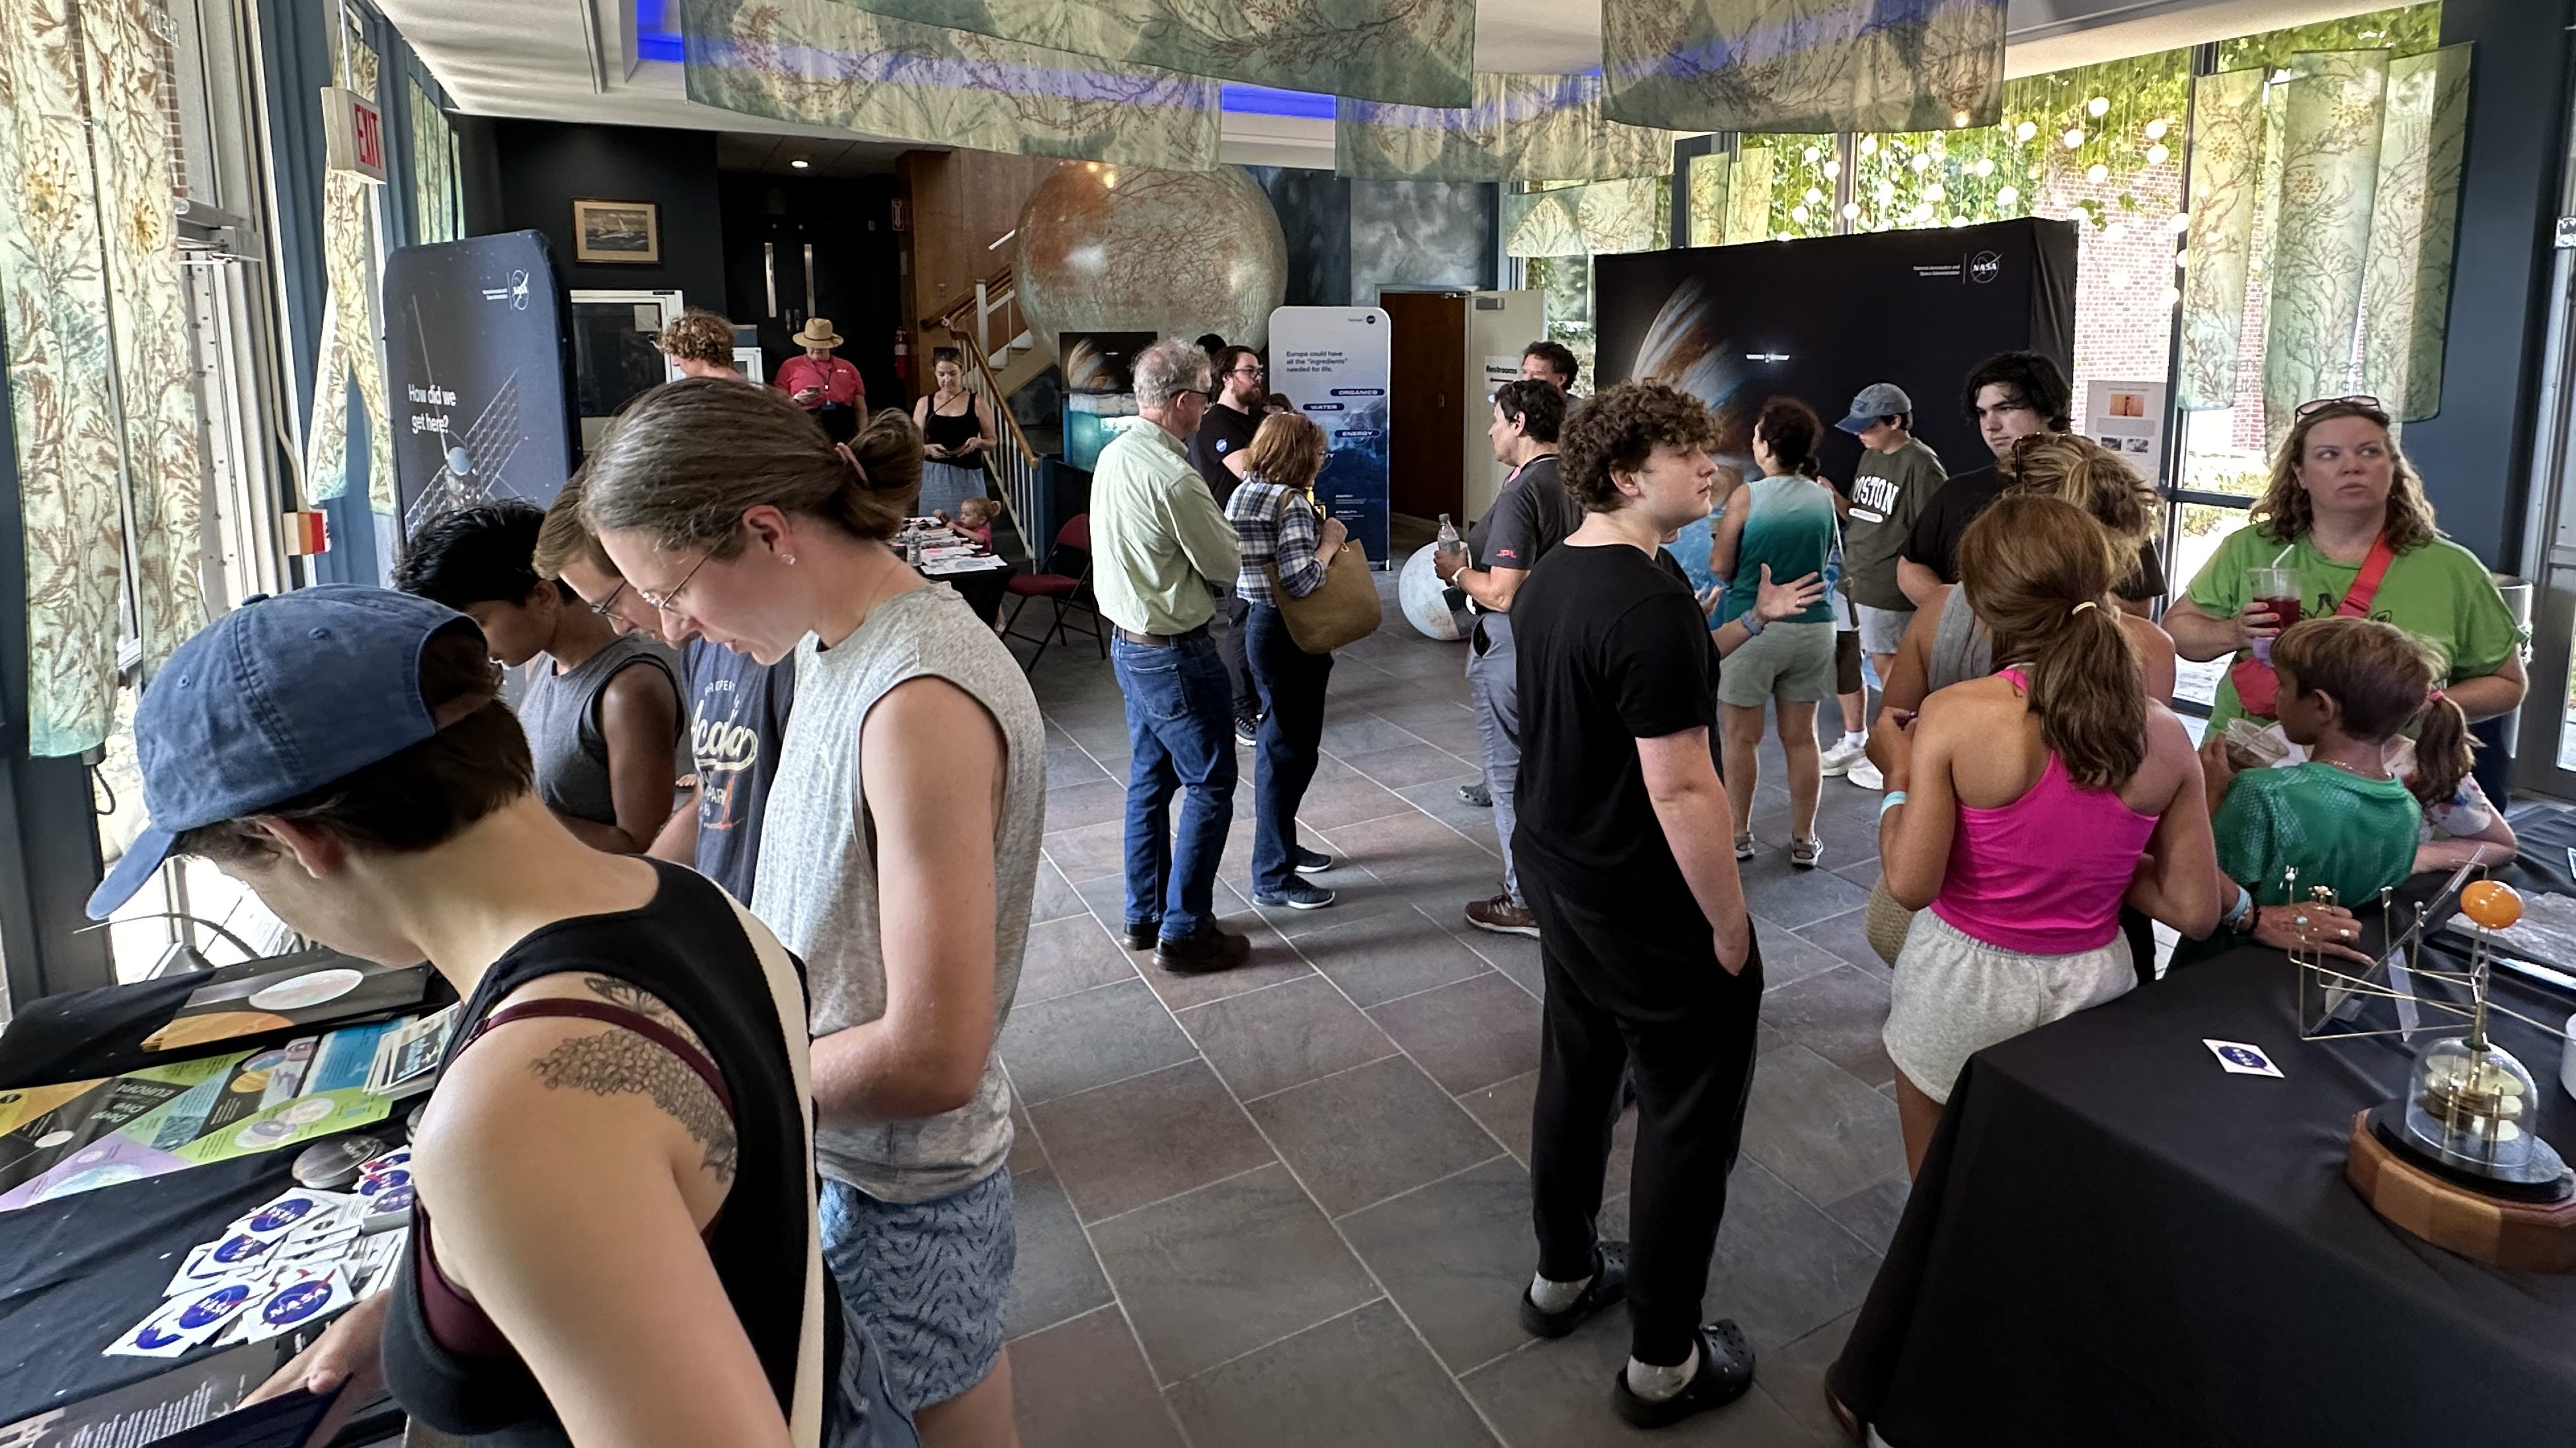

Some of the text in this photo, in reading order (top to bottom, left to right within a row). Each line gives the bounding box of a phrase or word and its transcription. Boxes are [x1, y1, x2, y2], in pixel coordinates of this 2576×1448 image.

[354, 103, 381, 170] EXIT
[1972, 262, 1998, 272] NASA
[1486, 365, 1518, 374] Restrooms
[408, 383, 456, 406] How did we
[412, 413, 449, 434] get here?
[1496, 549, 1517, 559] JPL
[115, 1084, 176, 1098] EUROPA
[112, 1102, 146, 1113] Dive
[90, 1110, 130, 1123] Deep
[270, 1287, 329, 1319] NASA
